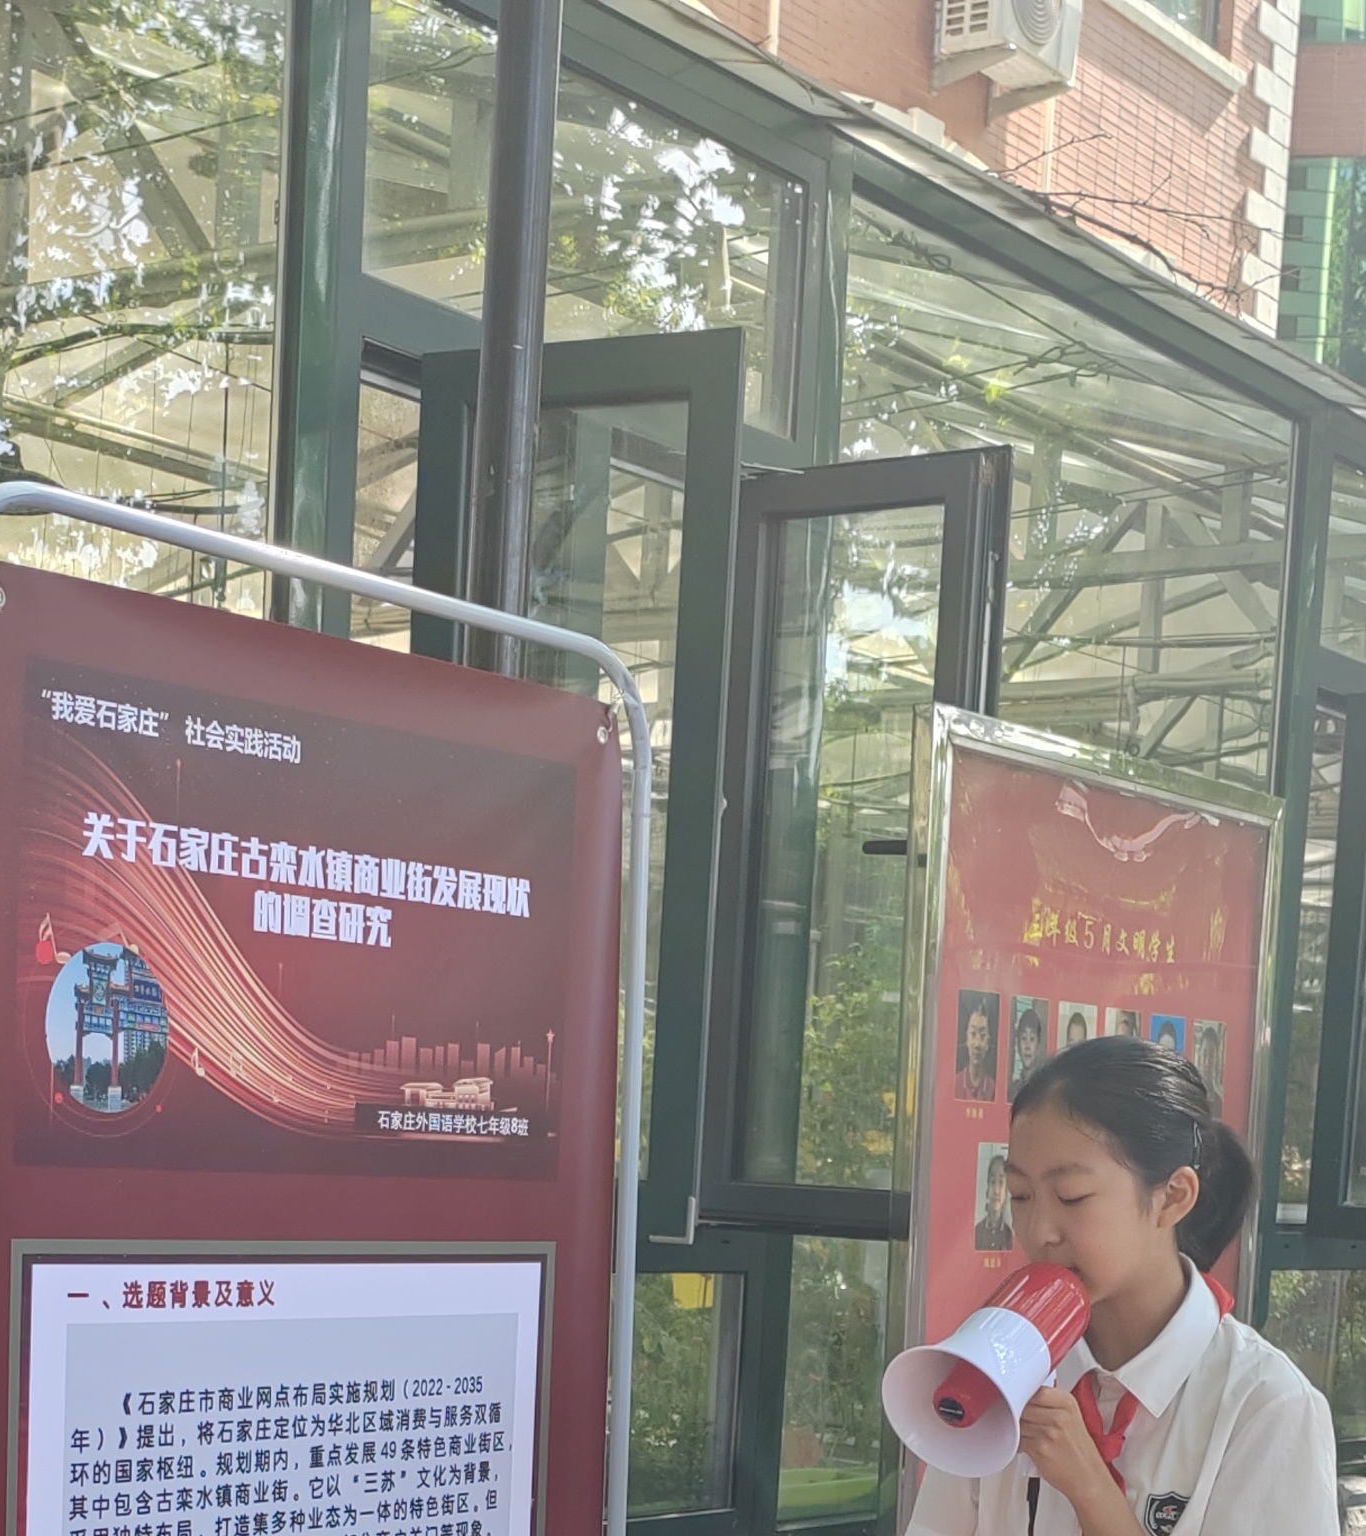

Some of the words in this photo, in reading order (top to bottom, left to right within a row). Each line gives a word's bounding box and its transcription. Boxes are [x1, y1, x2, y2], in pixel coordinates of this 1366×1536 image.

[41, 689, 170, 738] “我爱石家庄”
[184, 715, 302, 764] 社会实践活动
[81, 811, 531, 919] 关于石家庄古栾水镇商业街发展现状
[252, 889, 393, 948] 的调查研究
[377, 1109, 530, 1138] 石家庄外国语学校七年级8班
[67, 1279, 276, 1310] 一、选题背景及意义
[70, 1401, 502, 1454] 年）》提出，将石家庄定位为华北区域消费与服务双循
